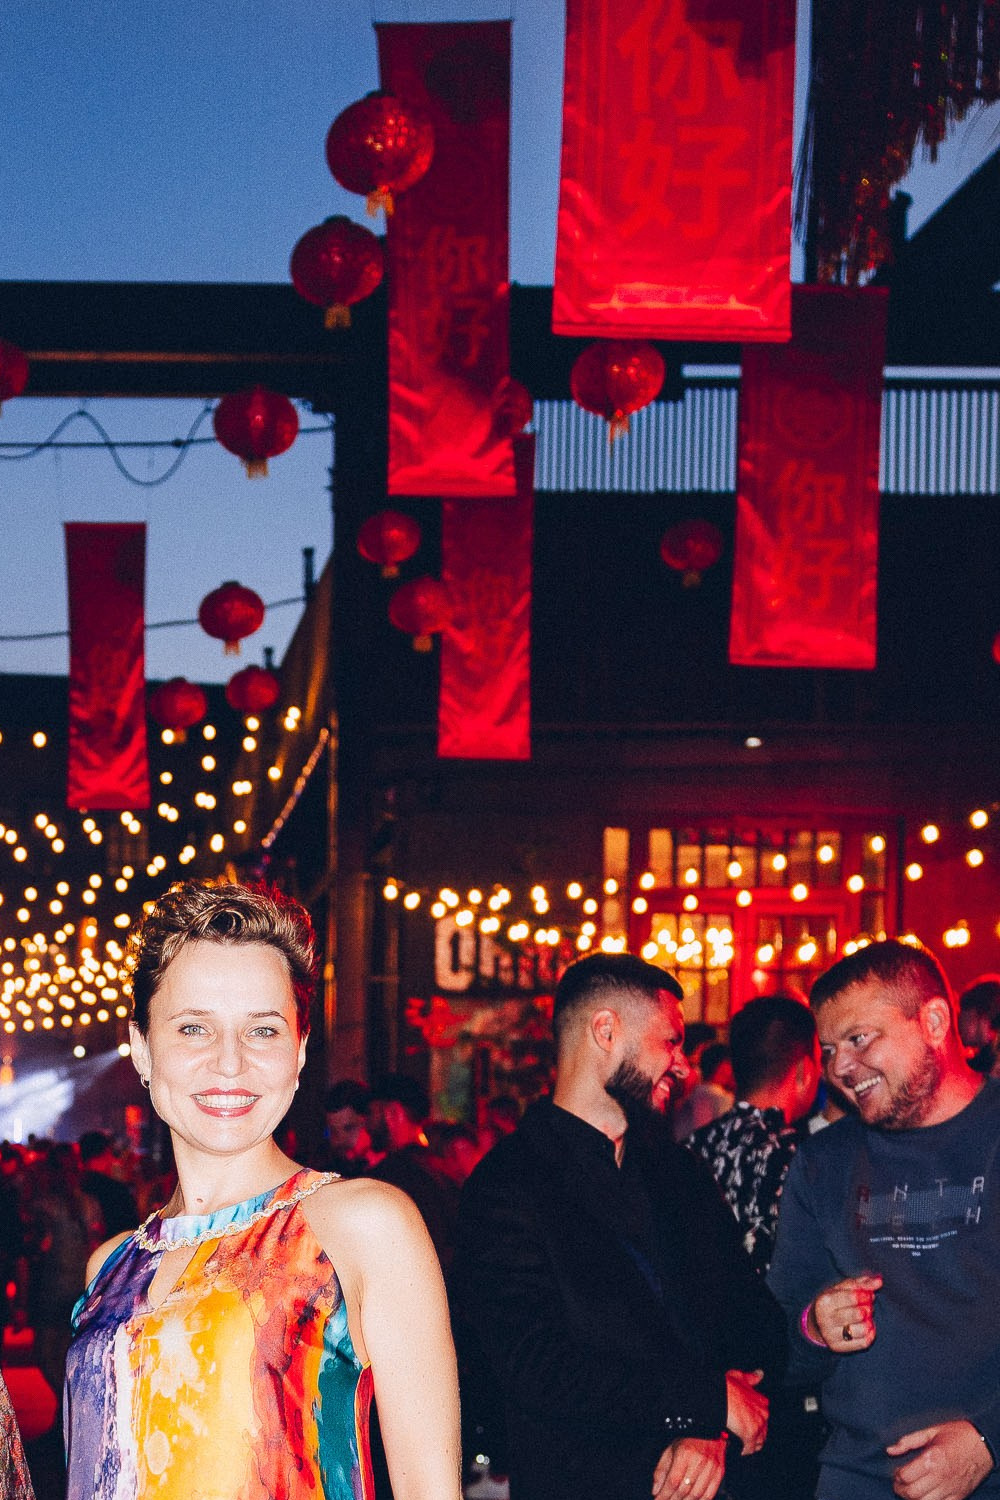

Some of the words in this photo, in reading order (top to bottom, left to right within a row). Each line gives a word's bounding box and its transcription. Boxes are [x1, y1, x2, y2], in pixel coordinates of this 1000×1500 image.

[614, 0, 750, 241] 你好
[420, 225, 490, 366] 你好
[770, 459, 850, 611] 你好
